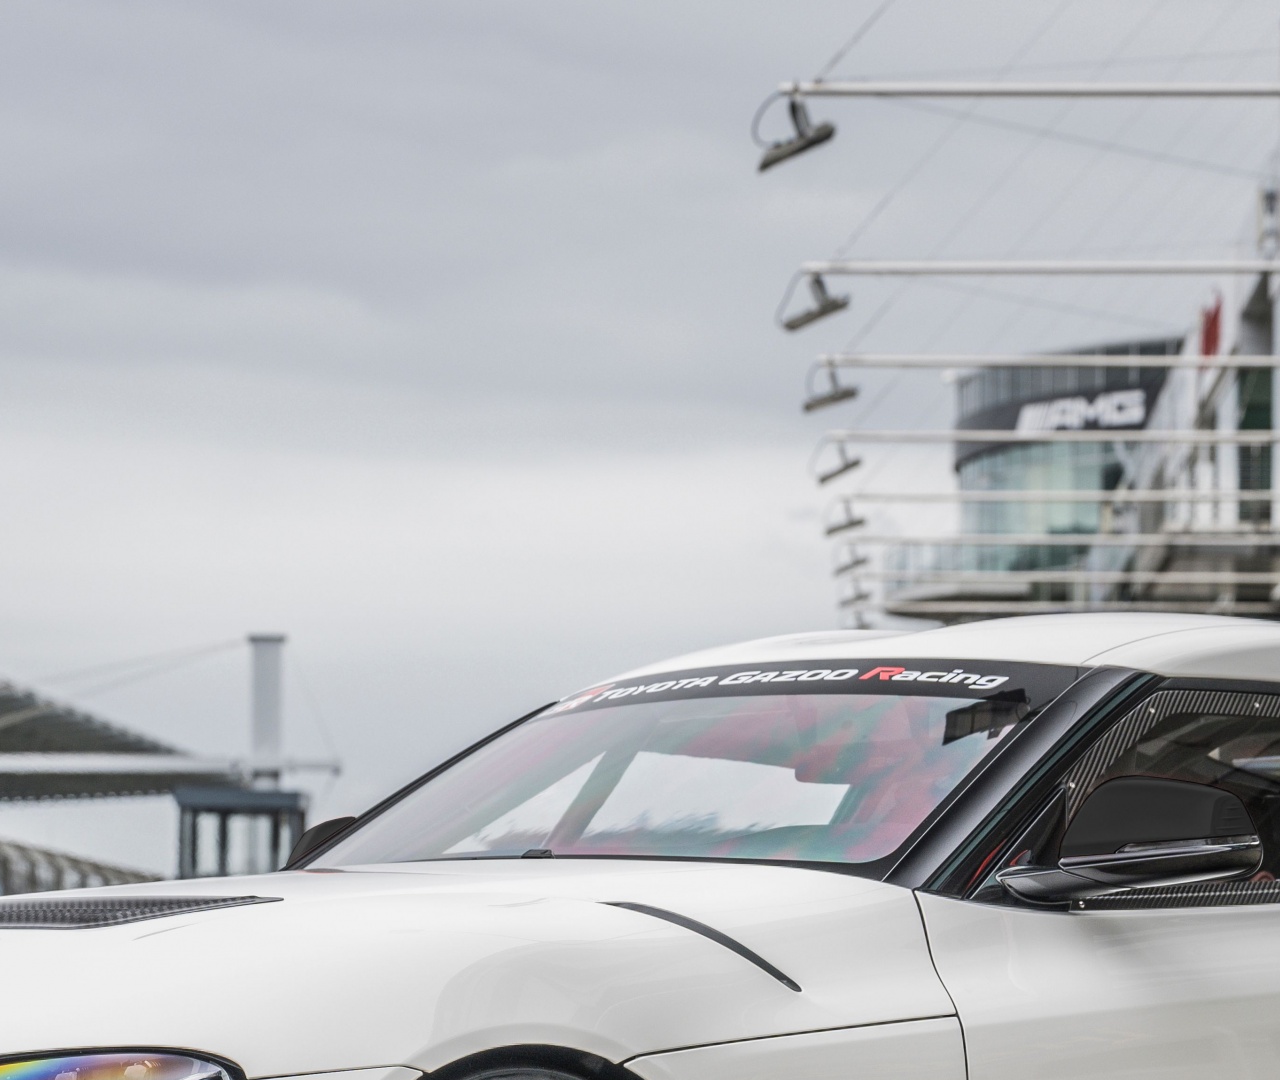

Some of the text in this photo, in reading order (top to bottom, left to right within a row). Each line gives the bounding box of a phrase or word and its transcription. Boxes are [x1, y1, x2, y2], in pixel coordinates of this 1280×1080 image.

[1048, 388, 1147, 430] AMG
[593, 676, 718, 702] TOYOTA
[718, 669, 859, 685] GAZOO
[859, 666, 1009, 689] Racing
